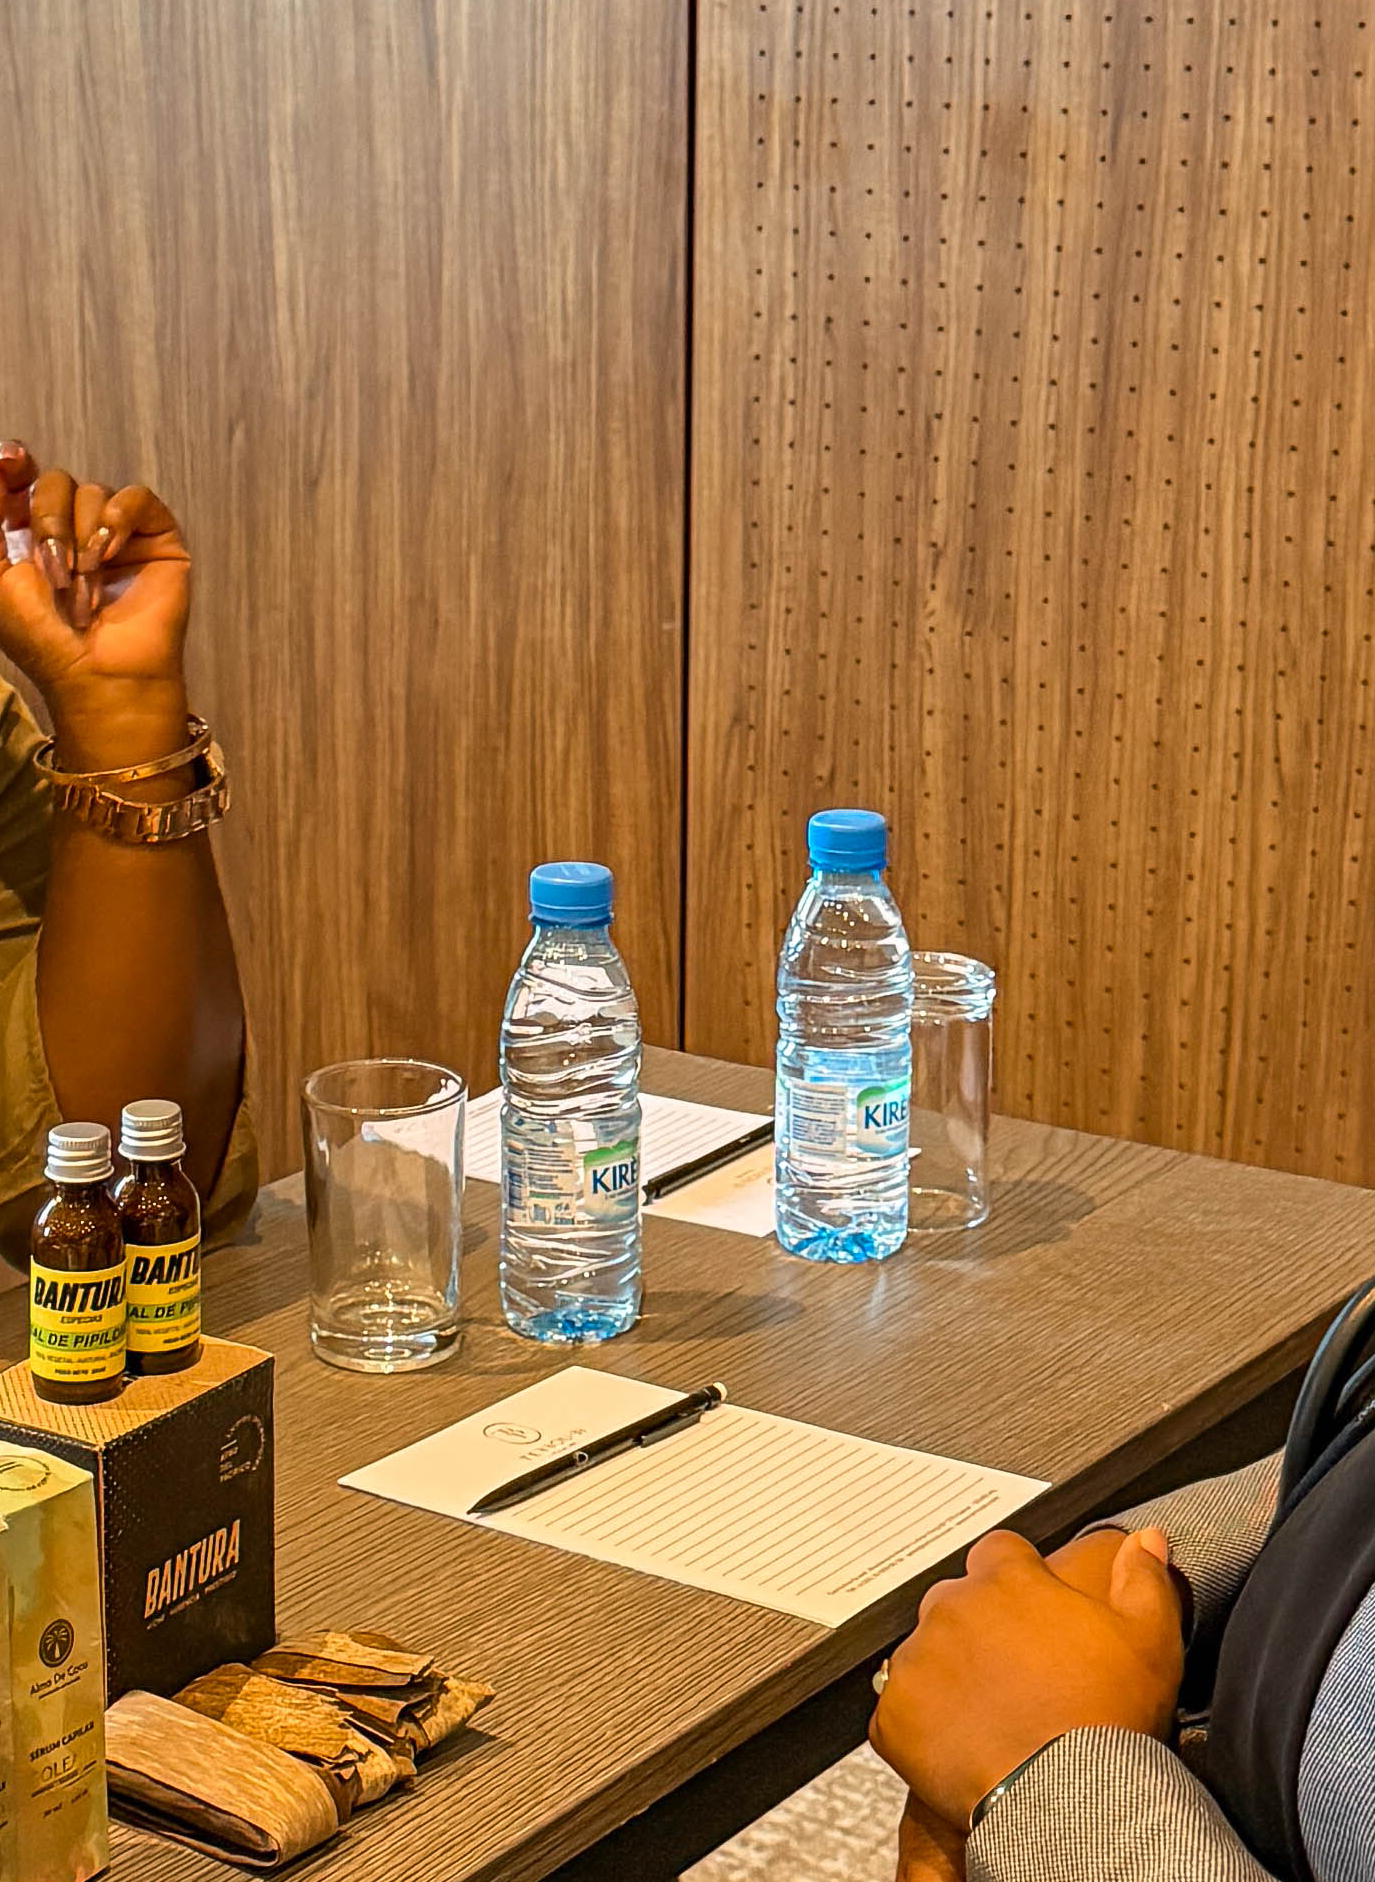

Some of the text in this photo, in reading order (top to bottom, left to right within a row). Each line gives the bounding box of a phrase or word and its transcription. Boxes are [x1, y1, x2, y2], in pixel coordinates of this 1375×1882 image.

[154, 1304, 176, 1318] DE
[47, 1333, 69, 1347] DE
[145, 1519, 240, 1618] BANTURA
[30, 1678, 52, 1695] Alma
